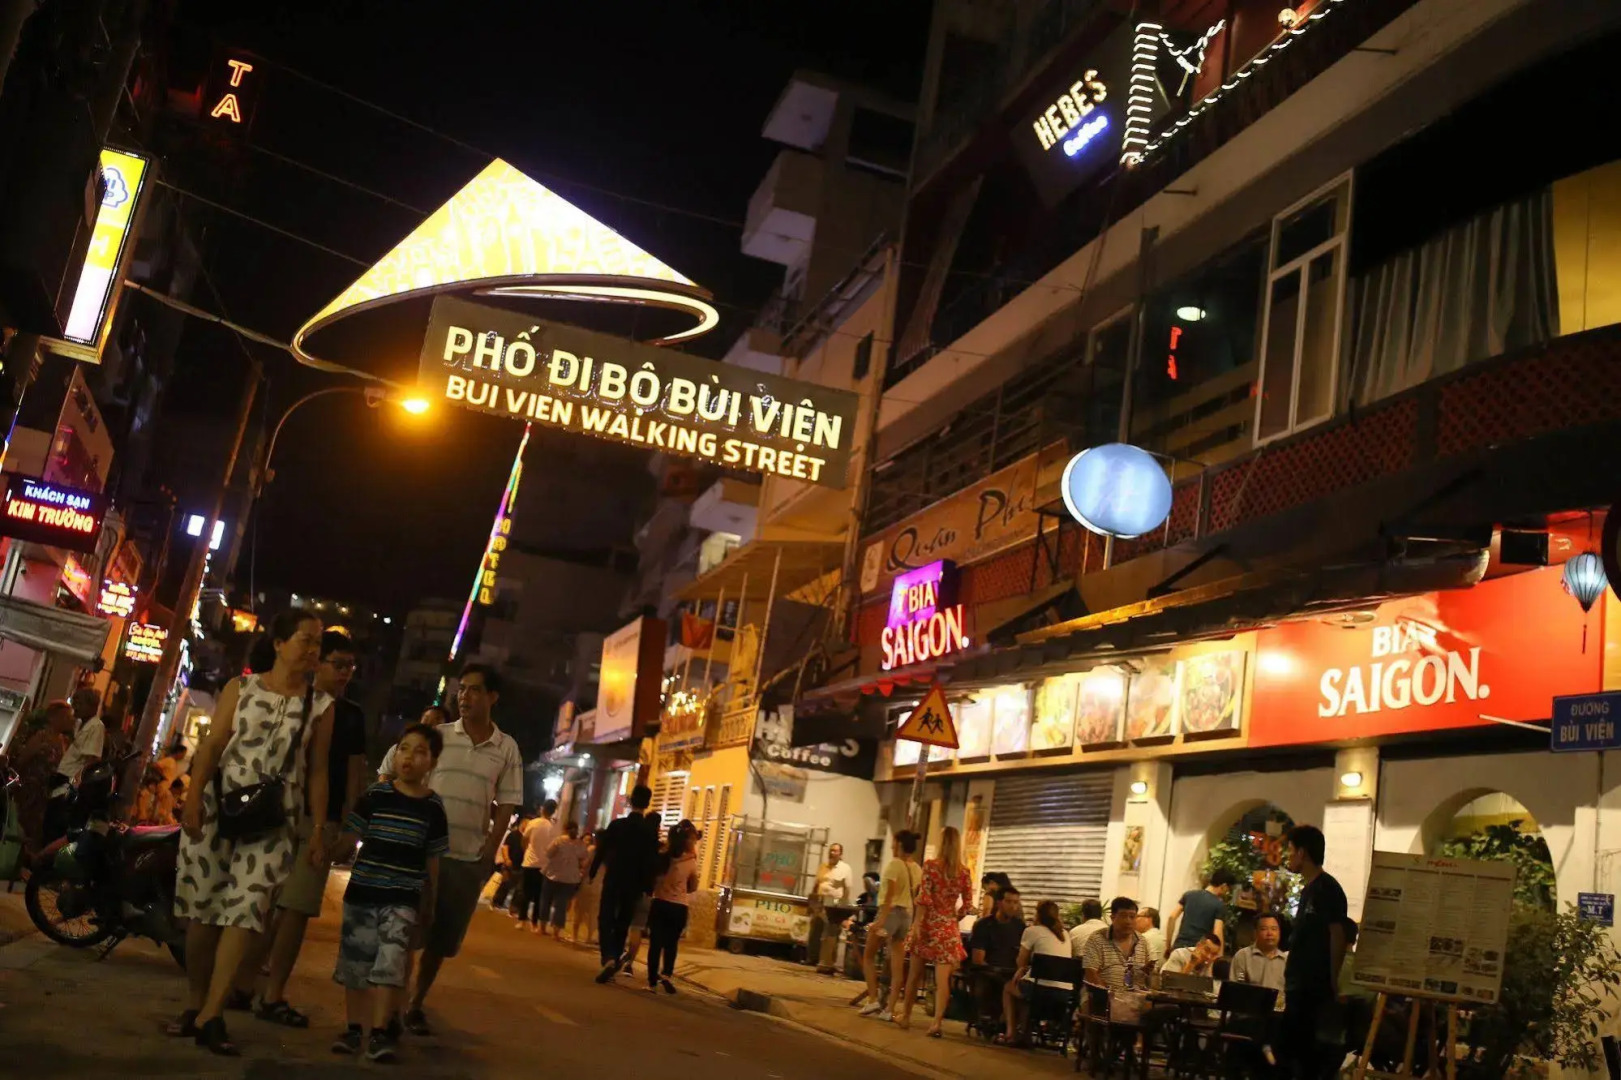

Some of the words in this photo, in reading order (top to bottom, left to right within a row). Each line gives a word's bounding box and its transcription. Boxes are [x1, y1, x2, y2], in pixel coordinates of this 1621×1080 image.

[443, 325, 539, 377] PHỐ
[547, 349, 593, 391] ĐI
[668, 375, 741, 427] BÙI
[445, 374, 501, 409] BUI
[506, 387, 574, 426] VIEN
[581, 404, 717, 457] WALKING
[722, 438, 826, 482] STREET
[7, 499, 36, 520] KIM
[25, 484, 65, 504] KHÁCH
[908, 580, 935, 613] BIA
[1371, 621, 1423, 658] BIA
[767, 743, 832, 767] Coffee
